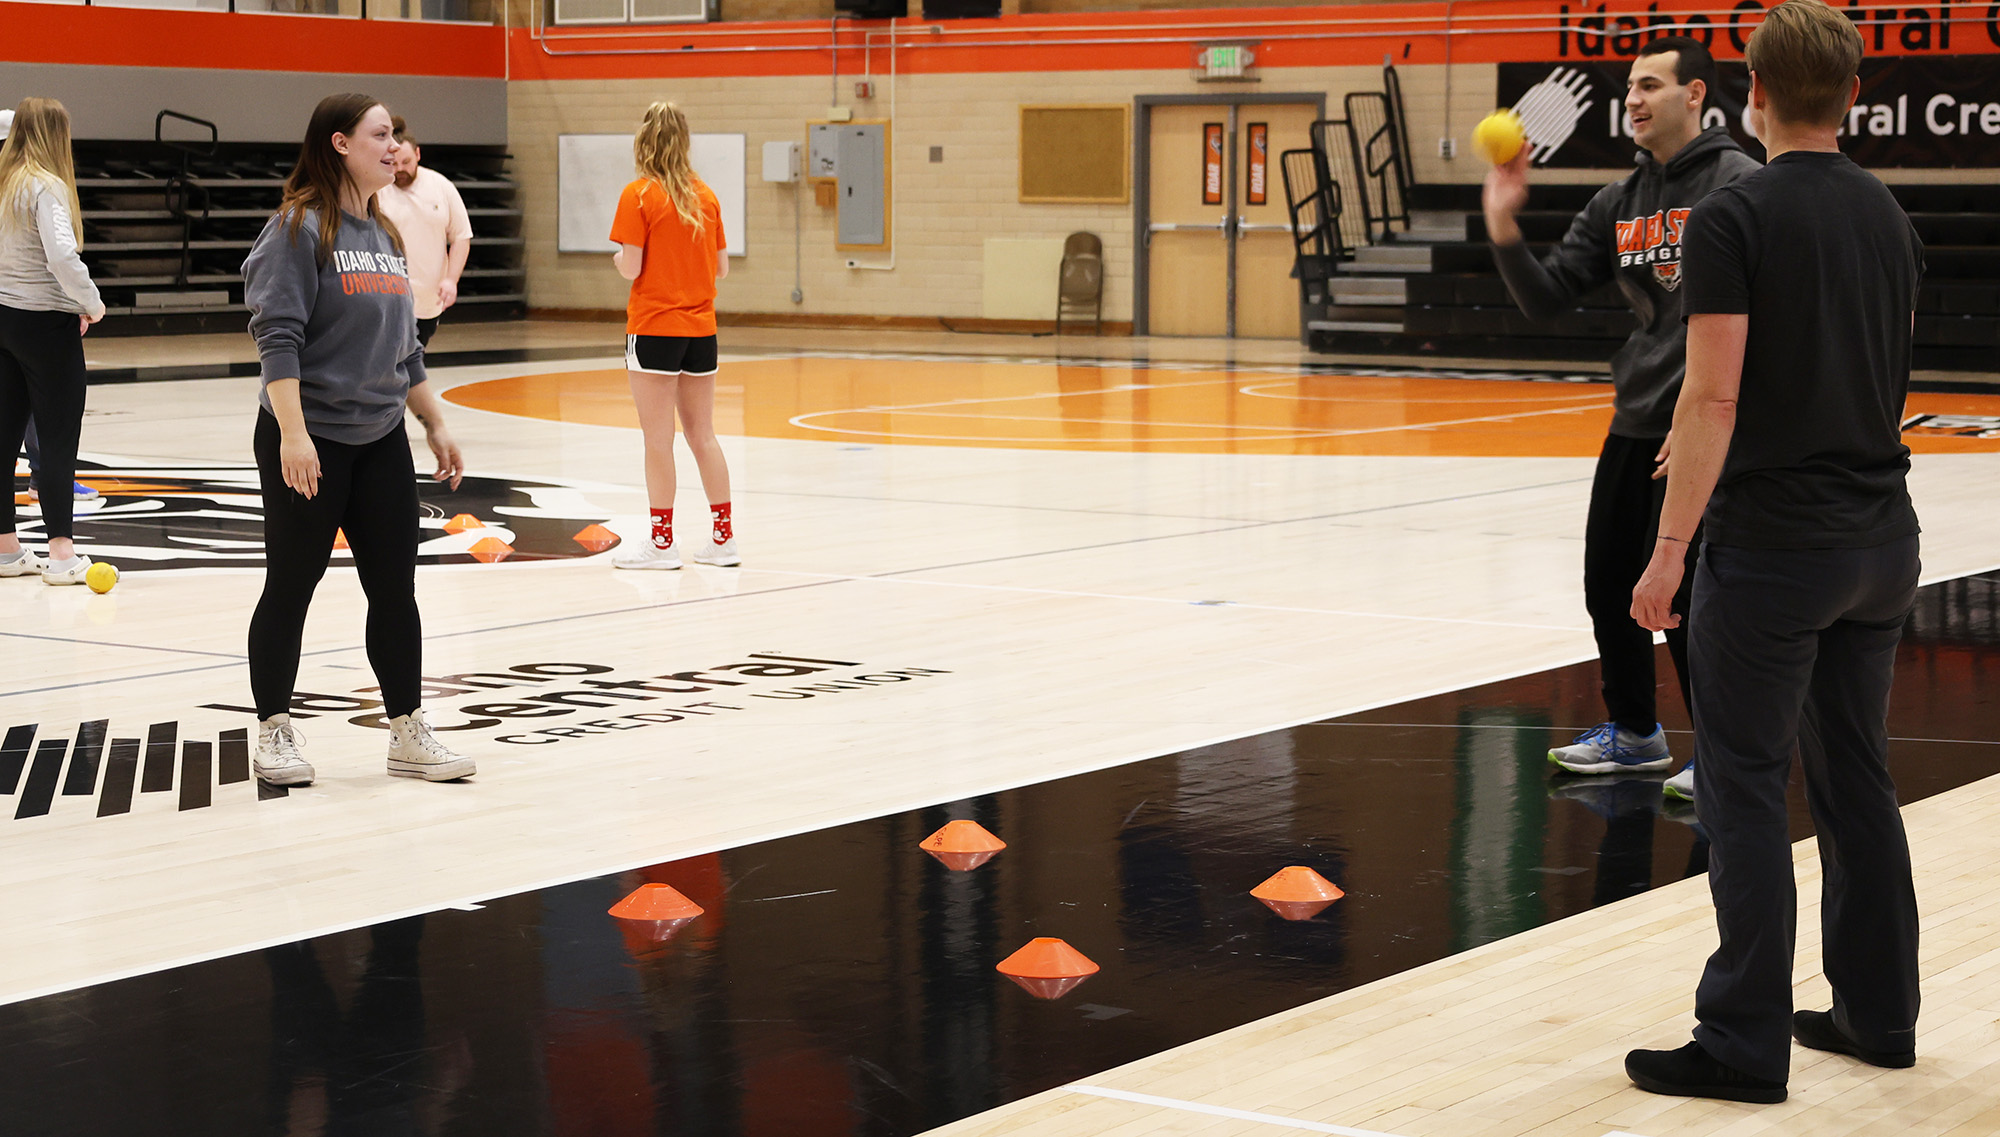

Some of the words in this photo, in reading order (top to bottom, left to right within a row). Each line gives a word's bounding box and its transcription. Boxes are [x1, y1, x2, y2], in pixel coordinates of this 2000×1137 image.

[1560, 3, 1713, 56] Idaho
[1213, 48, 1235, 68] EXIT
[1207, 163, 1220, 193] ROAR
[1251, 163, 1264, 193] ROAR
[333, 250, 377, 273] IDAHO
[375, 252, 408, 278] STATE
[494, 701, 745, 744] CREDIT
[750, 667, 954, 700] UNION
